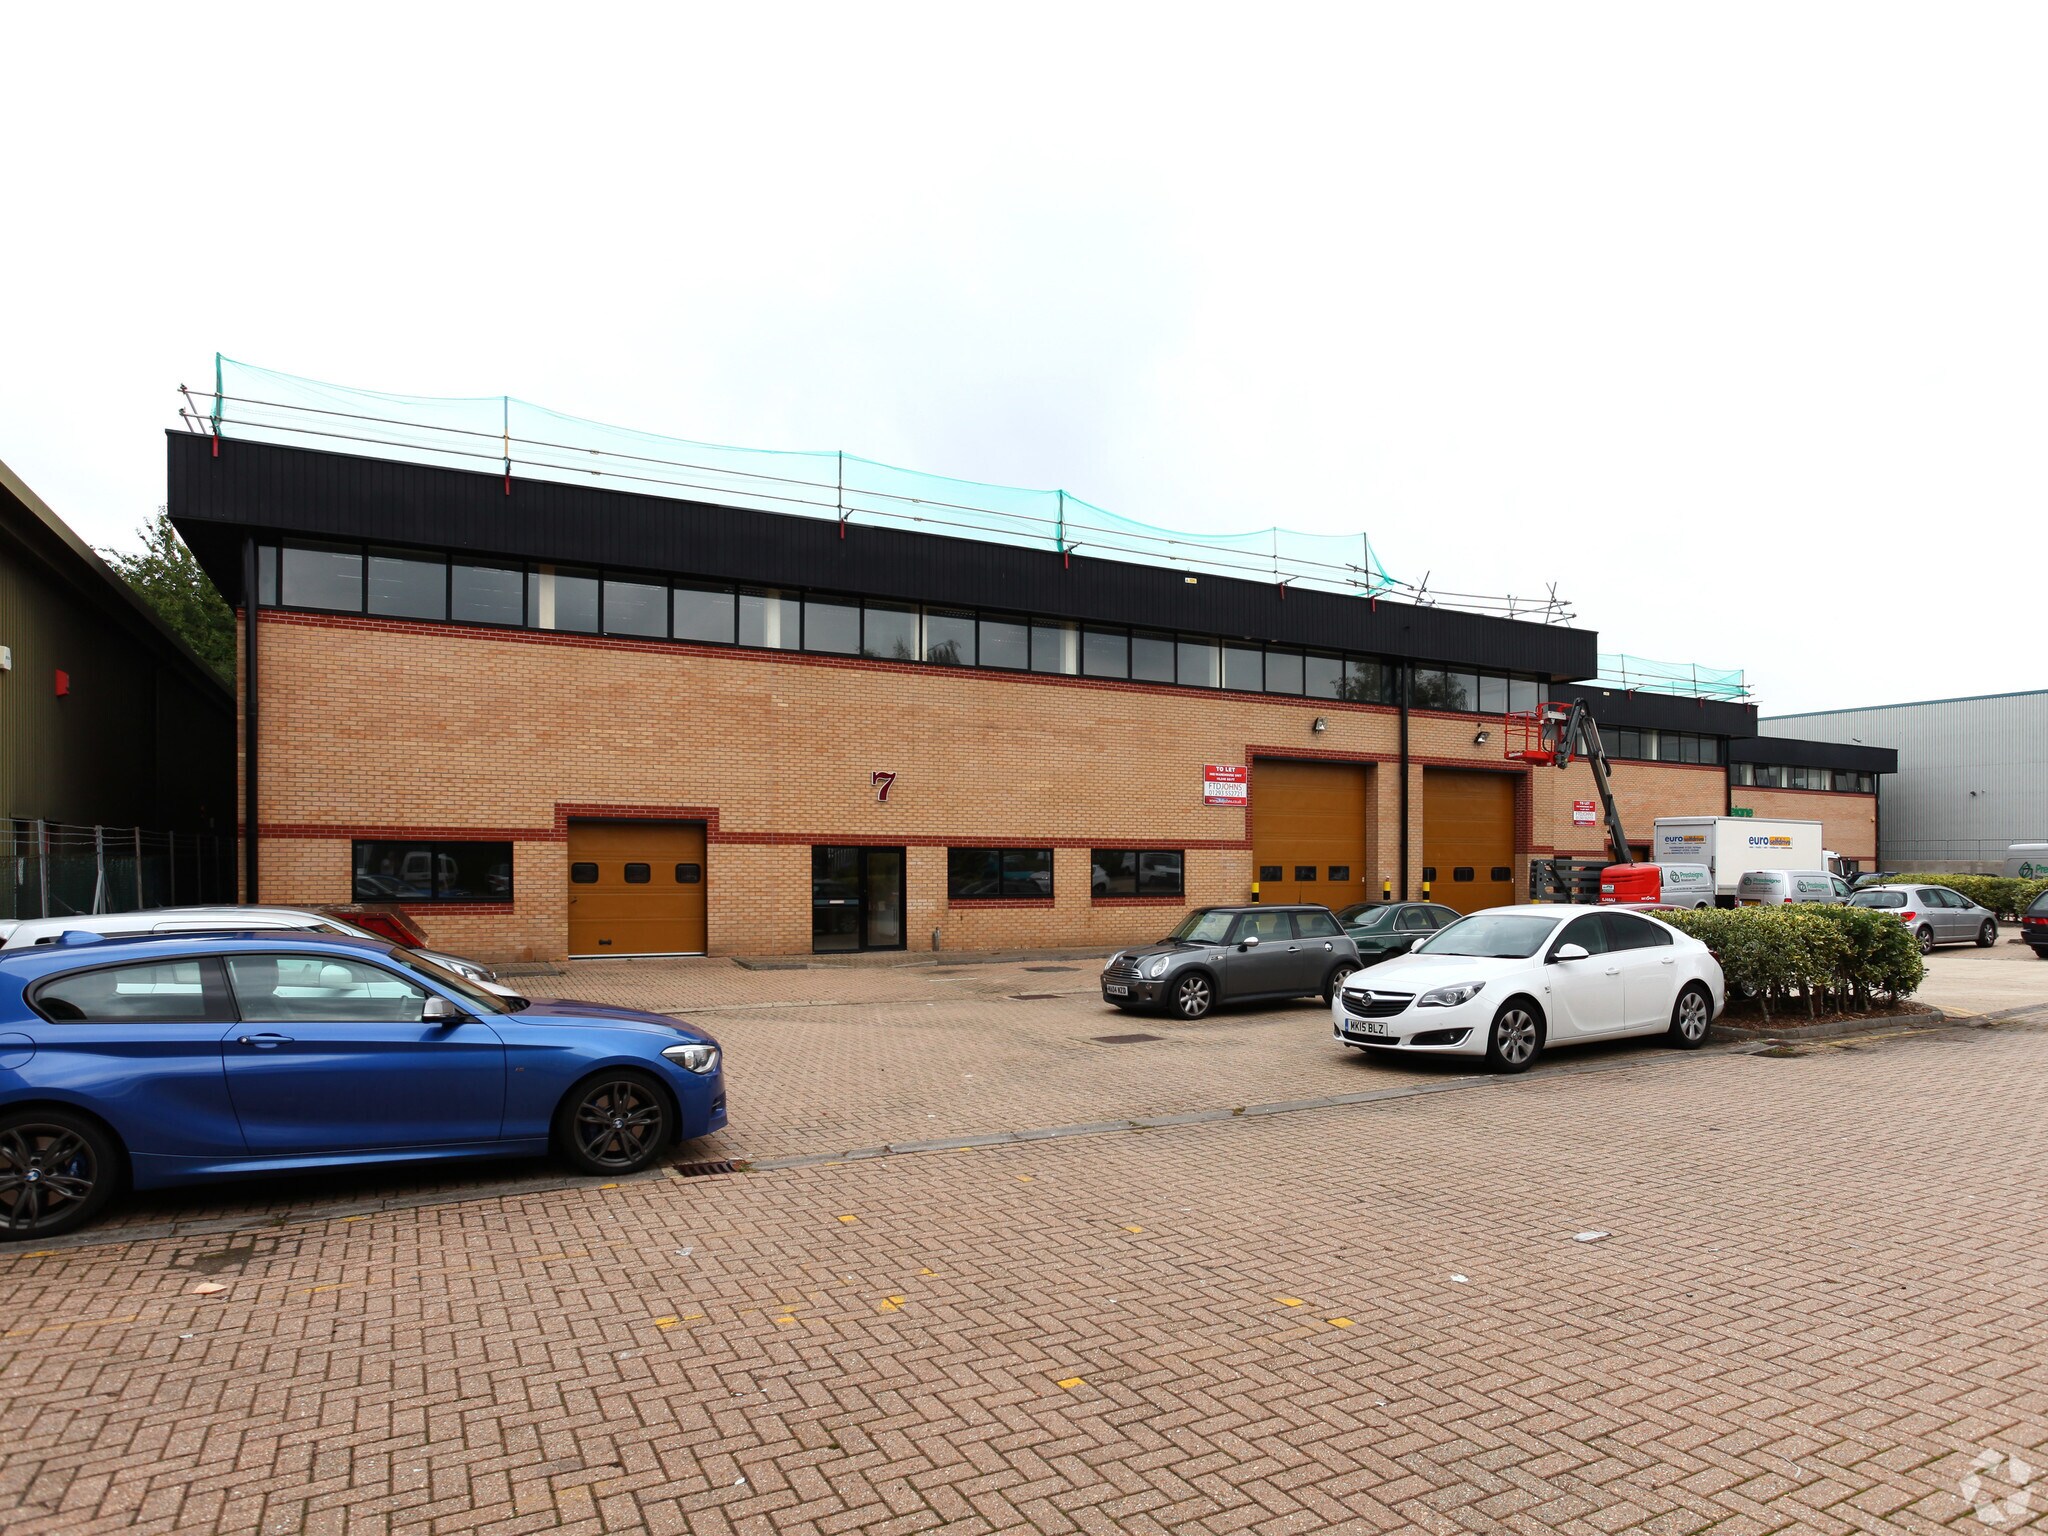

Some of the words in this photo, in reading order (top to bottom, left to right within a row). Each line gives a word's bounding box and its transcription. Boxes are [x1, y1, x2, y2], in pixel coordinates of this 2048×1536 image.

[871, 770, 897, 802] 7
[1748, 836, 1769, 845] euro
[1350, 1020, 1367, 1032] MK15
[1368, 1023, 1384, 1034] BLZ
